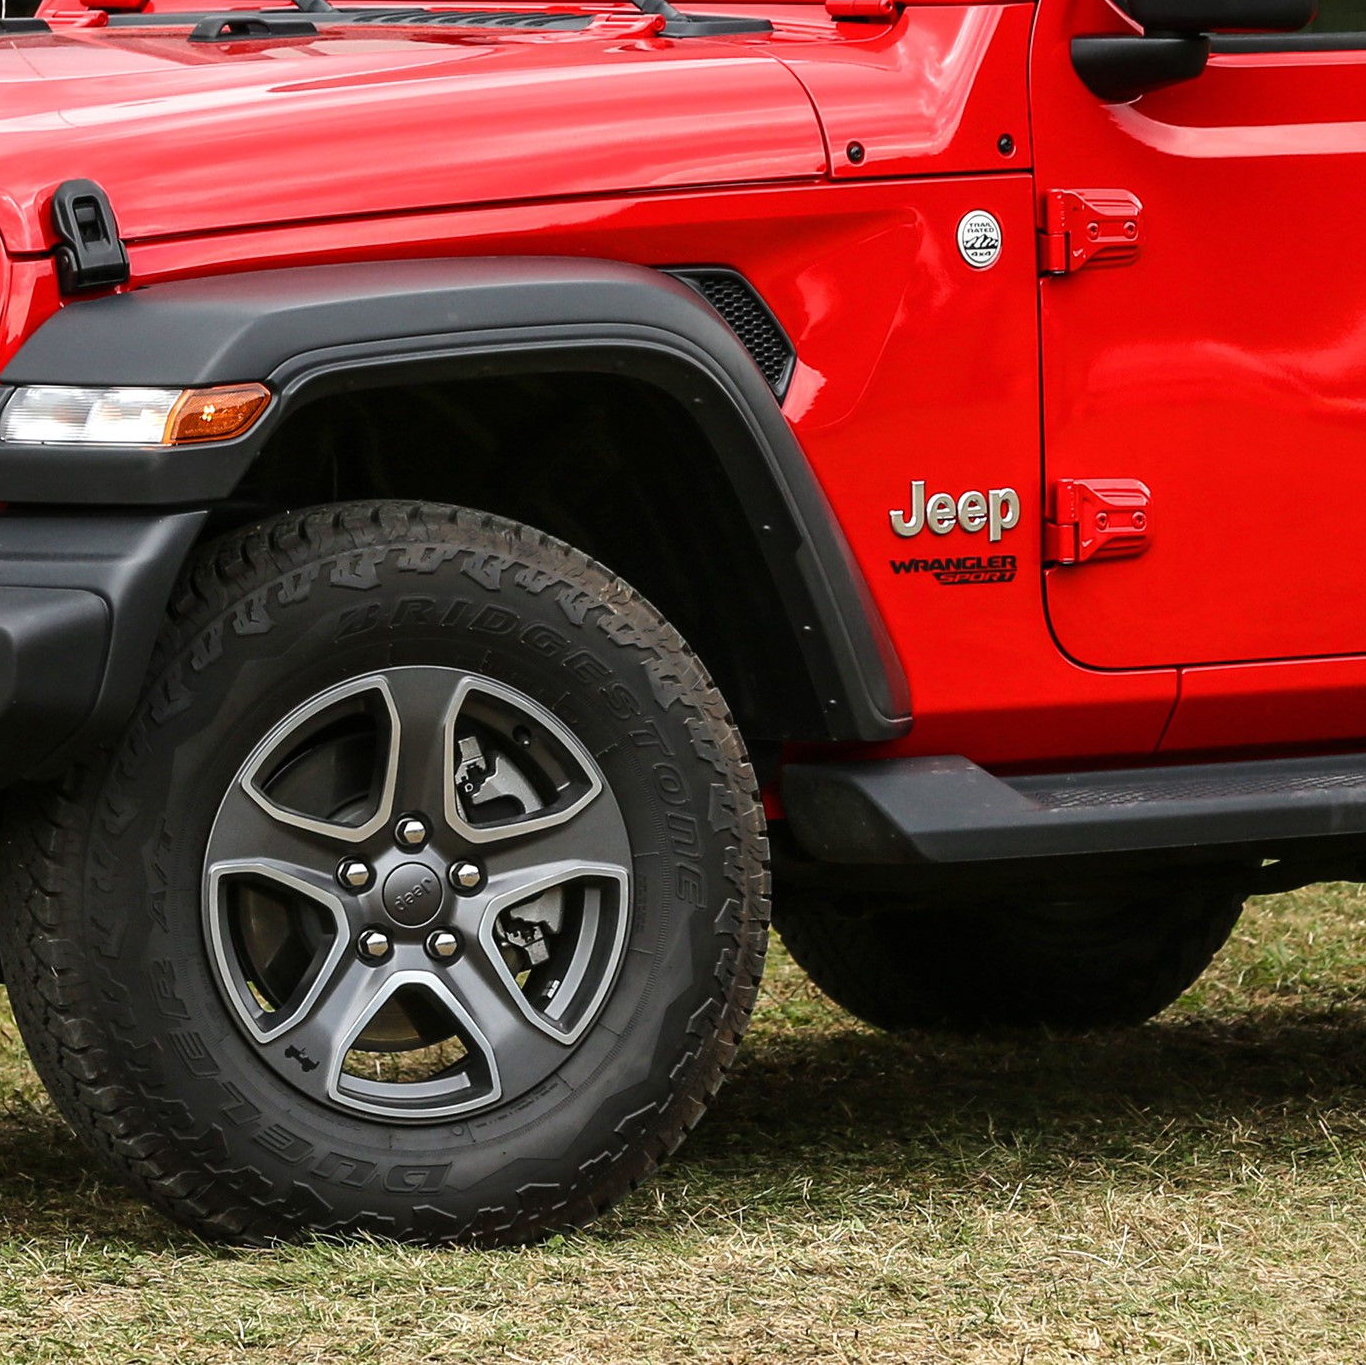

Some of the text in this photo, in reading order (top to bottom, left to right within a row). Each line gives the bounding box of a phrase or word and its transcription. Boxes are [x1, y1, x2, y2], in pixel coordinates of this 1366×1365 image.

[889, 480, 1021, 542] Jeep
[889, 555, 1017, 575] WRANGLER
[936, 571, 1014, 584] SPORT
[394, 877, 432, 911] Jeep
